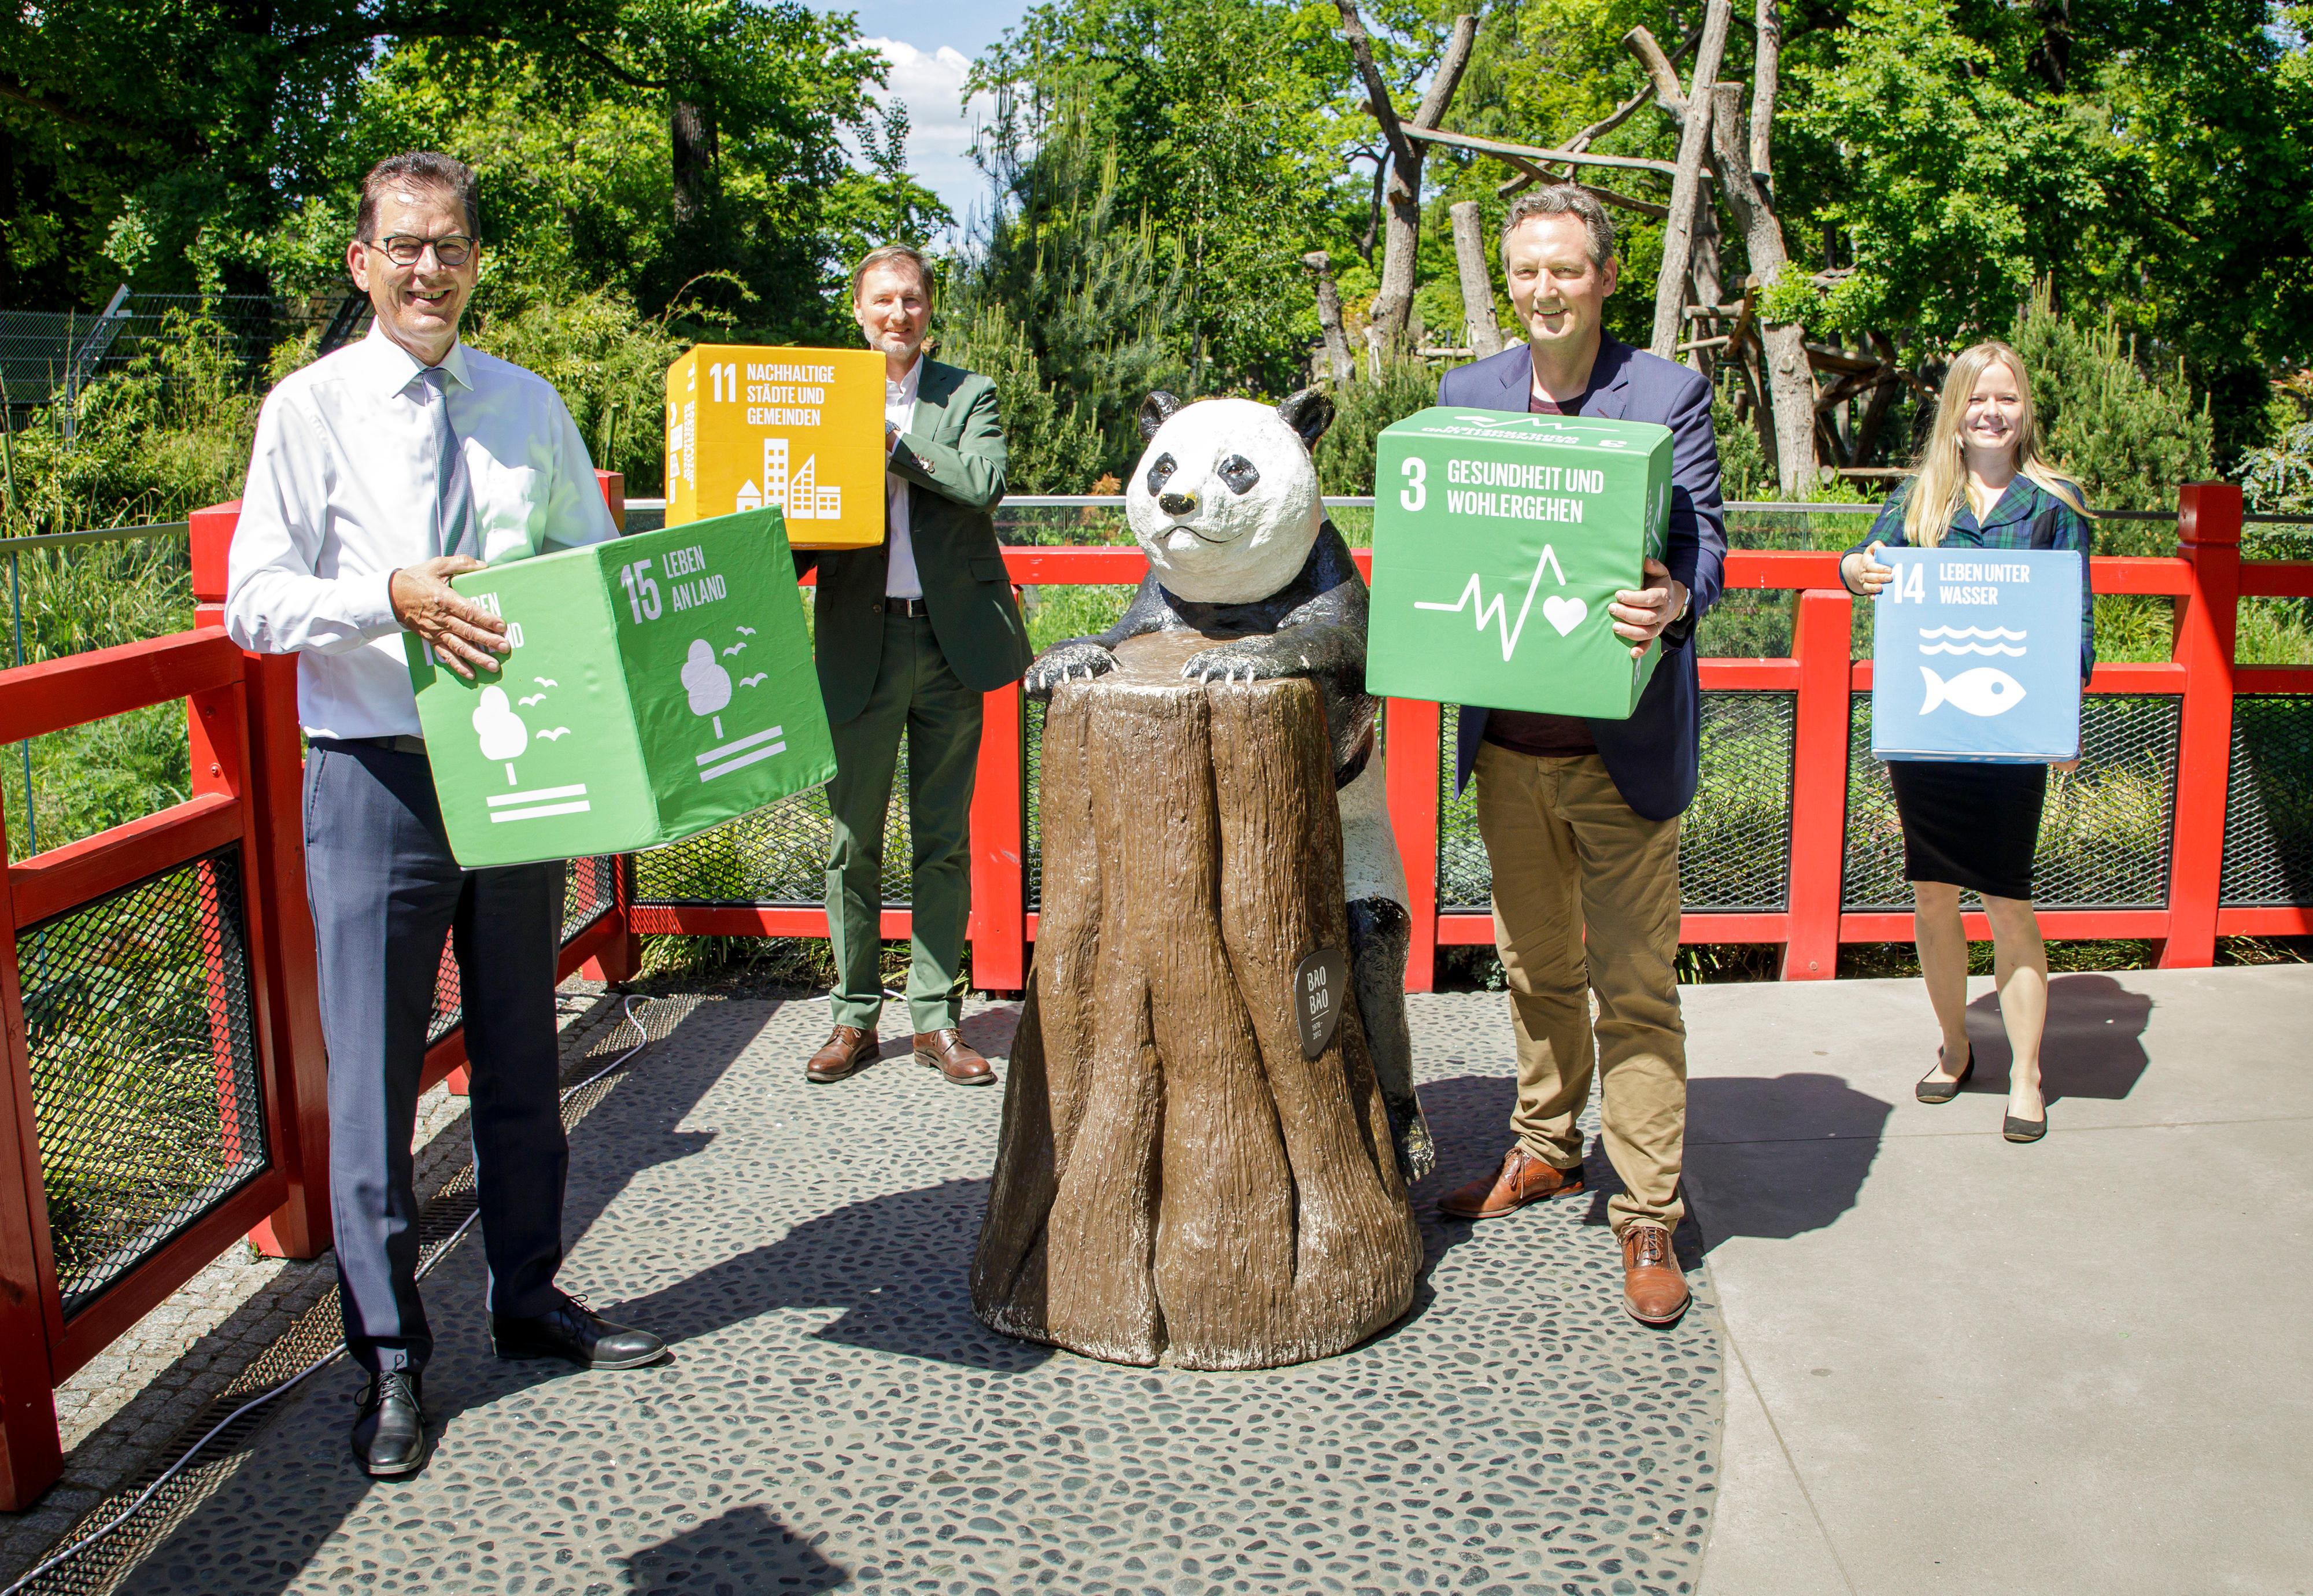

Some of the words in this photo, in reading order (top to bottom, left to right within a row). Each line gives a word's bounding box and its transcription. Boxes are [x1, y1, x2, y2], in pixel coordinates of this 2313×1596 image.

[710, 363, 736, 403] 11
[747, 364, 835, 383] NACHHALTIGE
[747, 383, 795, 404] STÄDTE
[798, 387, 825, 405] UND
[747, 408, 821, 426] GEMEINDEN
[1400, 457, 1427, 512] 3
[1447, 459, 1562, 491] GESUNDHEIT
[1565, 468, 1604, 494] UND
[1447, 489, 1583, 523] WOHLERGEHEN
[662, 545, 707, 579] LEBEN
[1939, 563, 1982, 582] LEBEN
[1985, 564, 2030, 583] UNTER
[620, 559, 663, 625] 15
[672, 583, 692, 612] AN
[691, 574, 727, 607] LAND
[1891, 563, 1926, 604] 14
[1939, 586, 1998, 605] WASSER
[1307, 966, 1327, 992] BAO
[1309, 988, 1329, 1015] BAO
[1313, 1029, 1322, 1040] 2012
